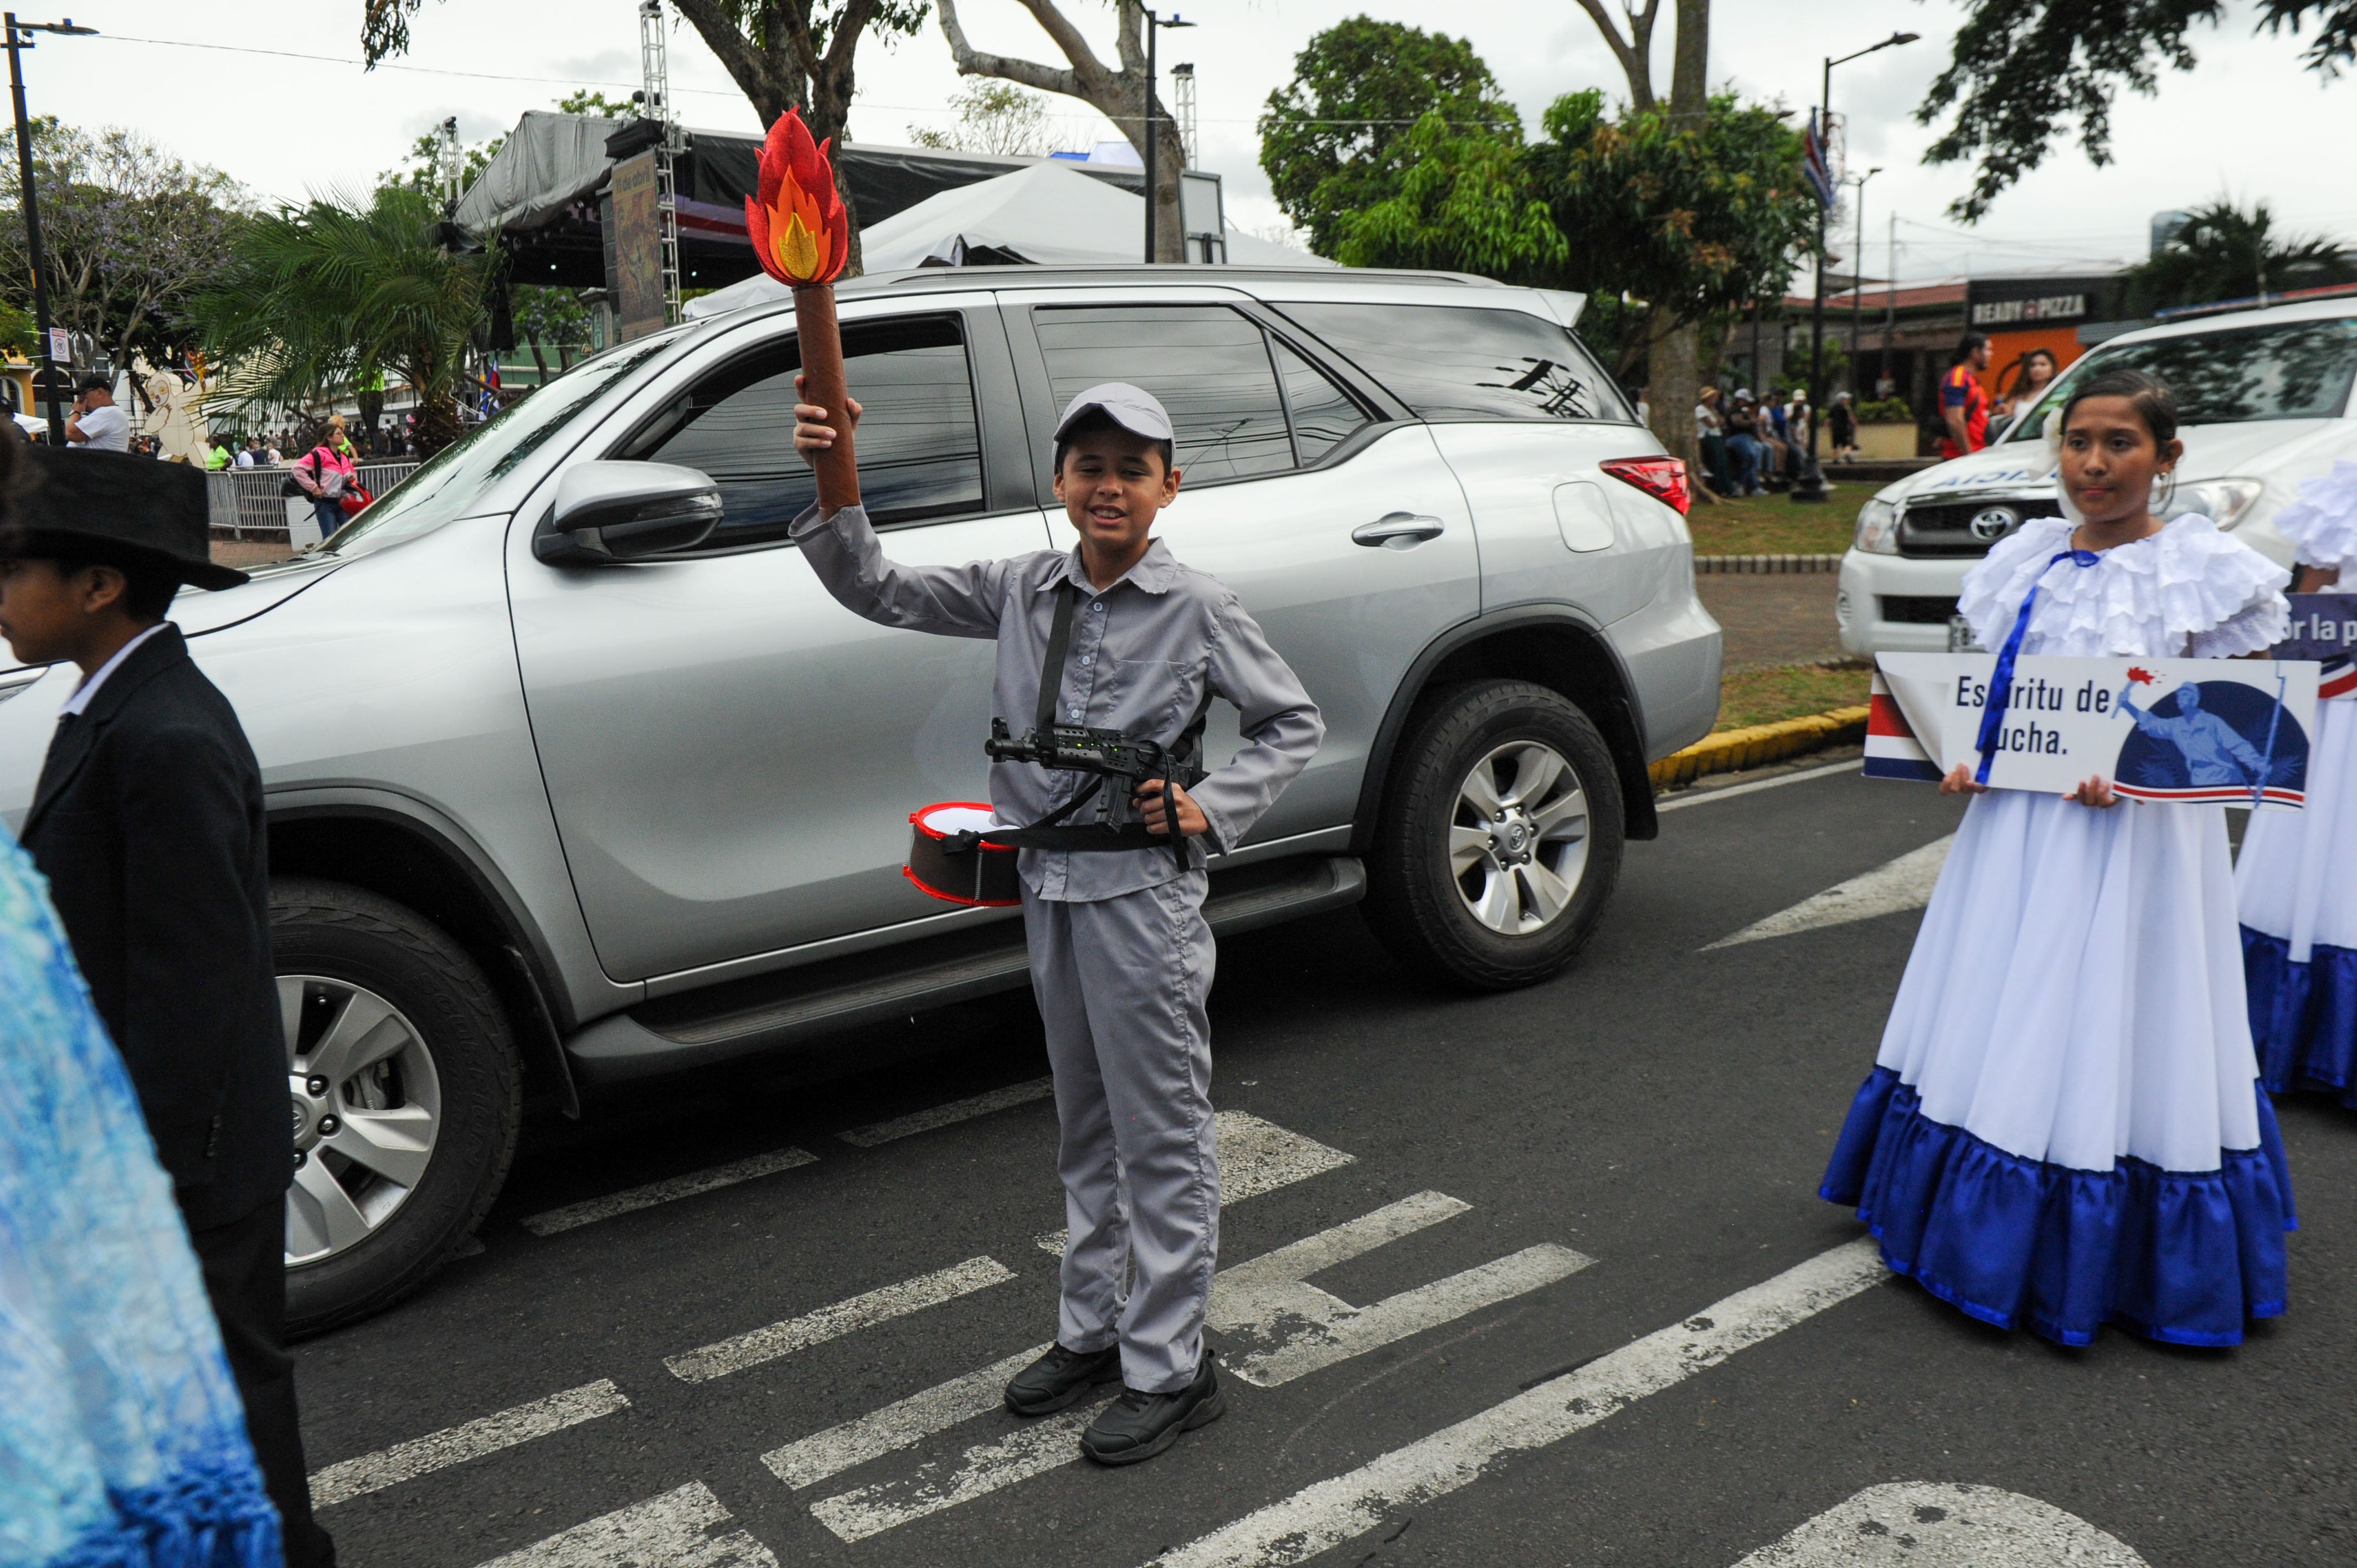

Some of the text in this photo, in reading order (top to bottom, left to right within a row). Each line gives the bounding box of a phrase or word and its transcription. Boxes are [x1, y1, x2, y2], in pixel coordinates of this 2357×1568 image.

[633, 164, 650, 187] abril
[2037, 294, 2086, 317] PIZZA
[2311, 613, 2337, 641] la
[1957, 675, 2109, 713] Esíritu de
[1990, 721, 2067, 754] ucha.
